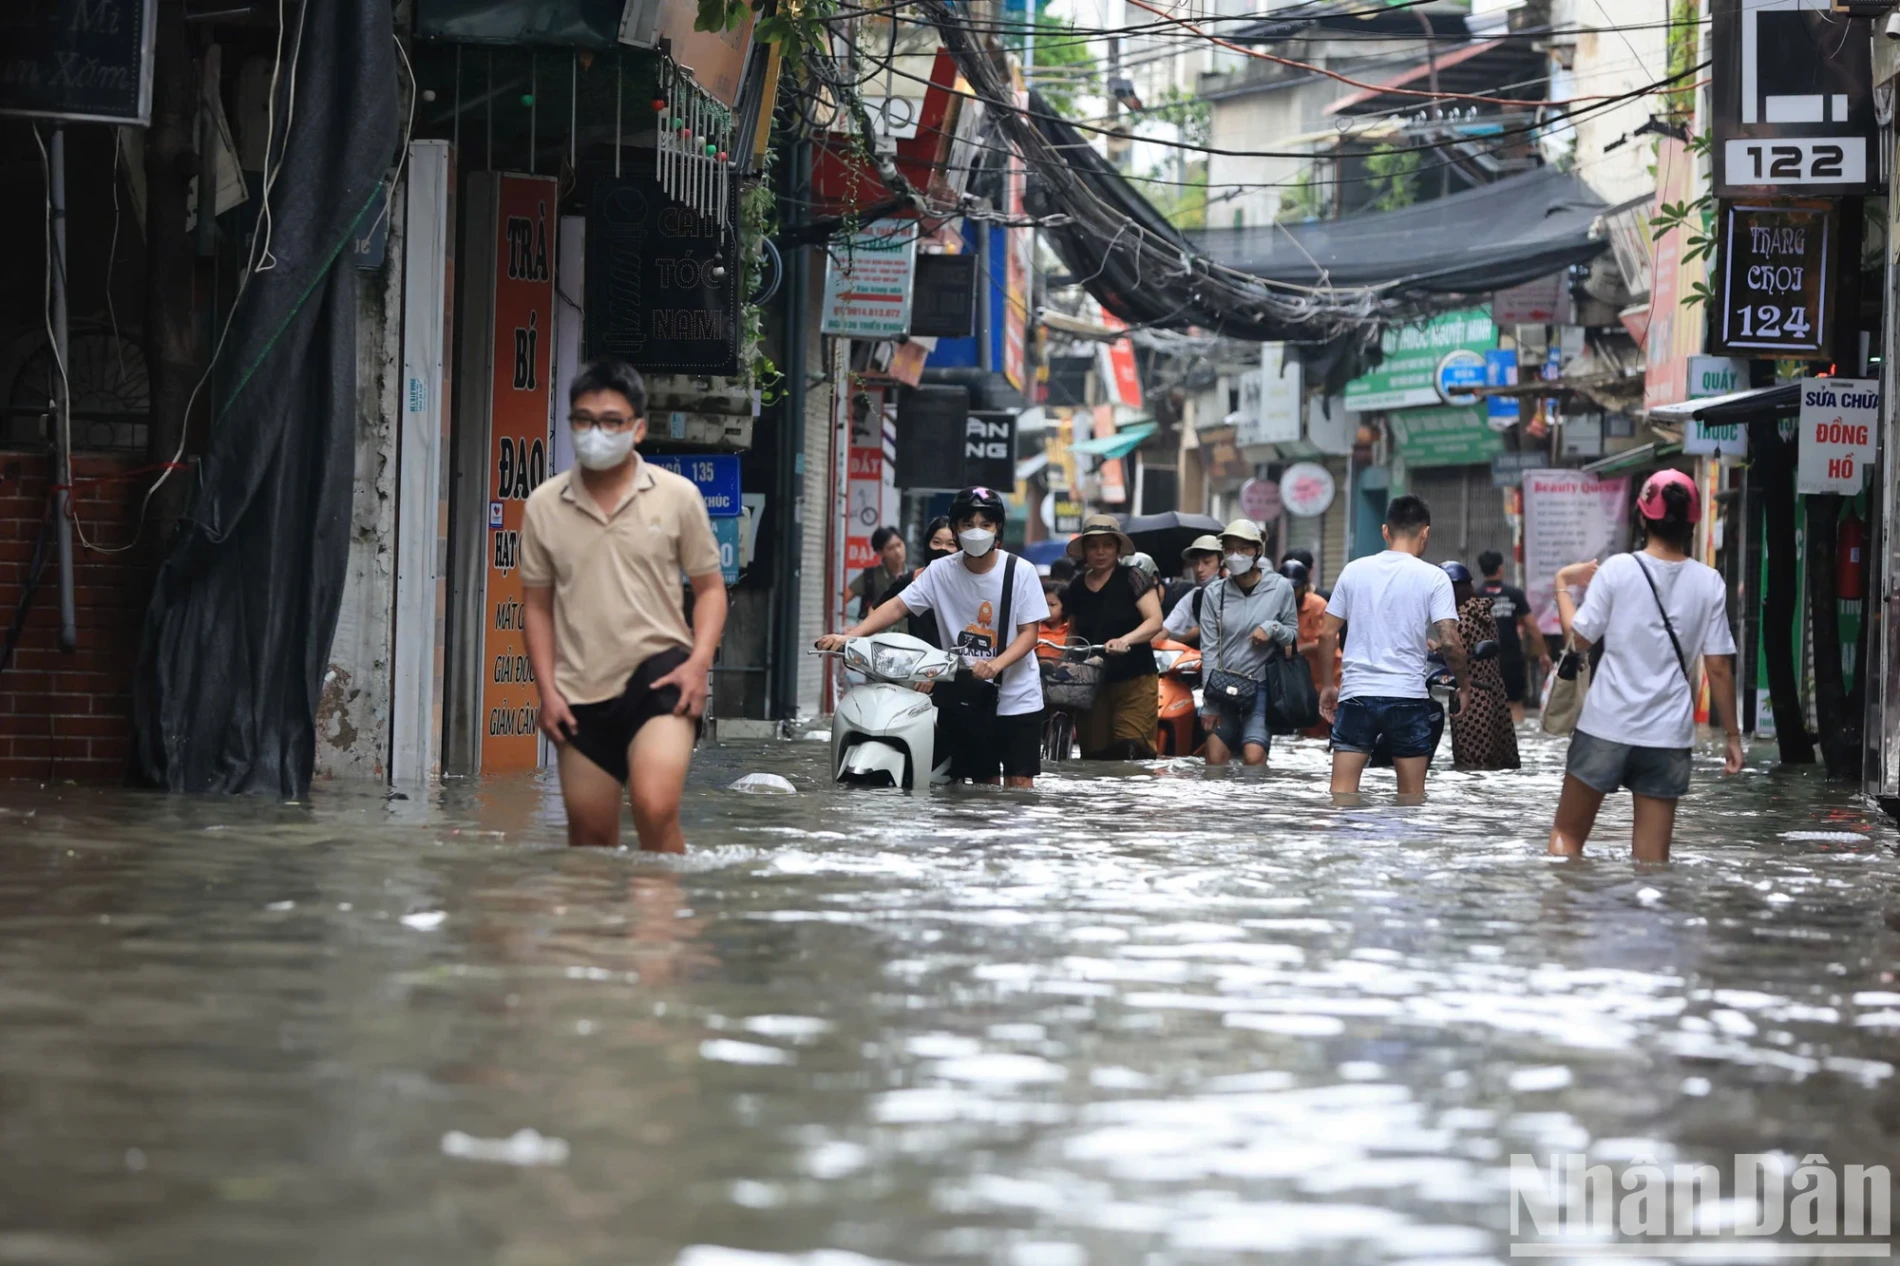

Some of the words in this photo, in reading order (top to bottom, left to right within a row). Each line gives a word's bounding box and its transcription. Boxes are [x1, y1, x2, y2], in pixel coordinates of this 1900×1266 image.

[1747, 145, 1843, 179] 122
[507, 201, 550, 283] TRÀ
[655, 249, 722, 289] TÓC
[652, 308, 722, 341] NAM
[1737, 304, 1810, 338] 124
[514, 311, 537, 390] BÍ
[1805, 386, 1837, 408] SỬA
[1816, 416, 1868, 446] ĐỒNG
[498, 438, 546, 500] ĐAO
[692, 461, 714, 482] 135
[1828, 452, 1854, 479] HỒ
[495, 531, 516, 576] HẠT
[495, 597, 518, 631] MÁT
[494, 647, 514, 684] GIẢI
[489, 698, 514, 737] GIẢM
[517, 701, 538, 737] CÂN
